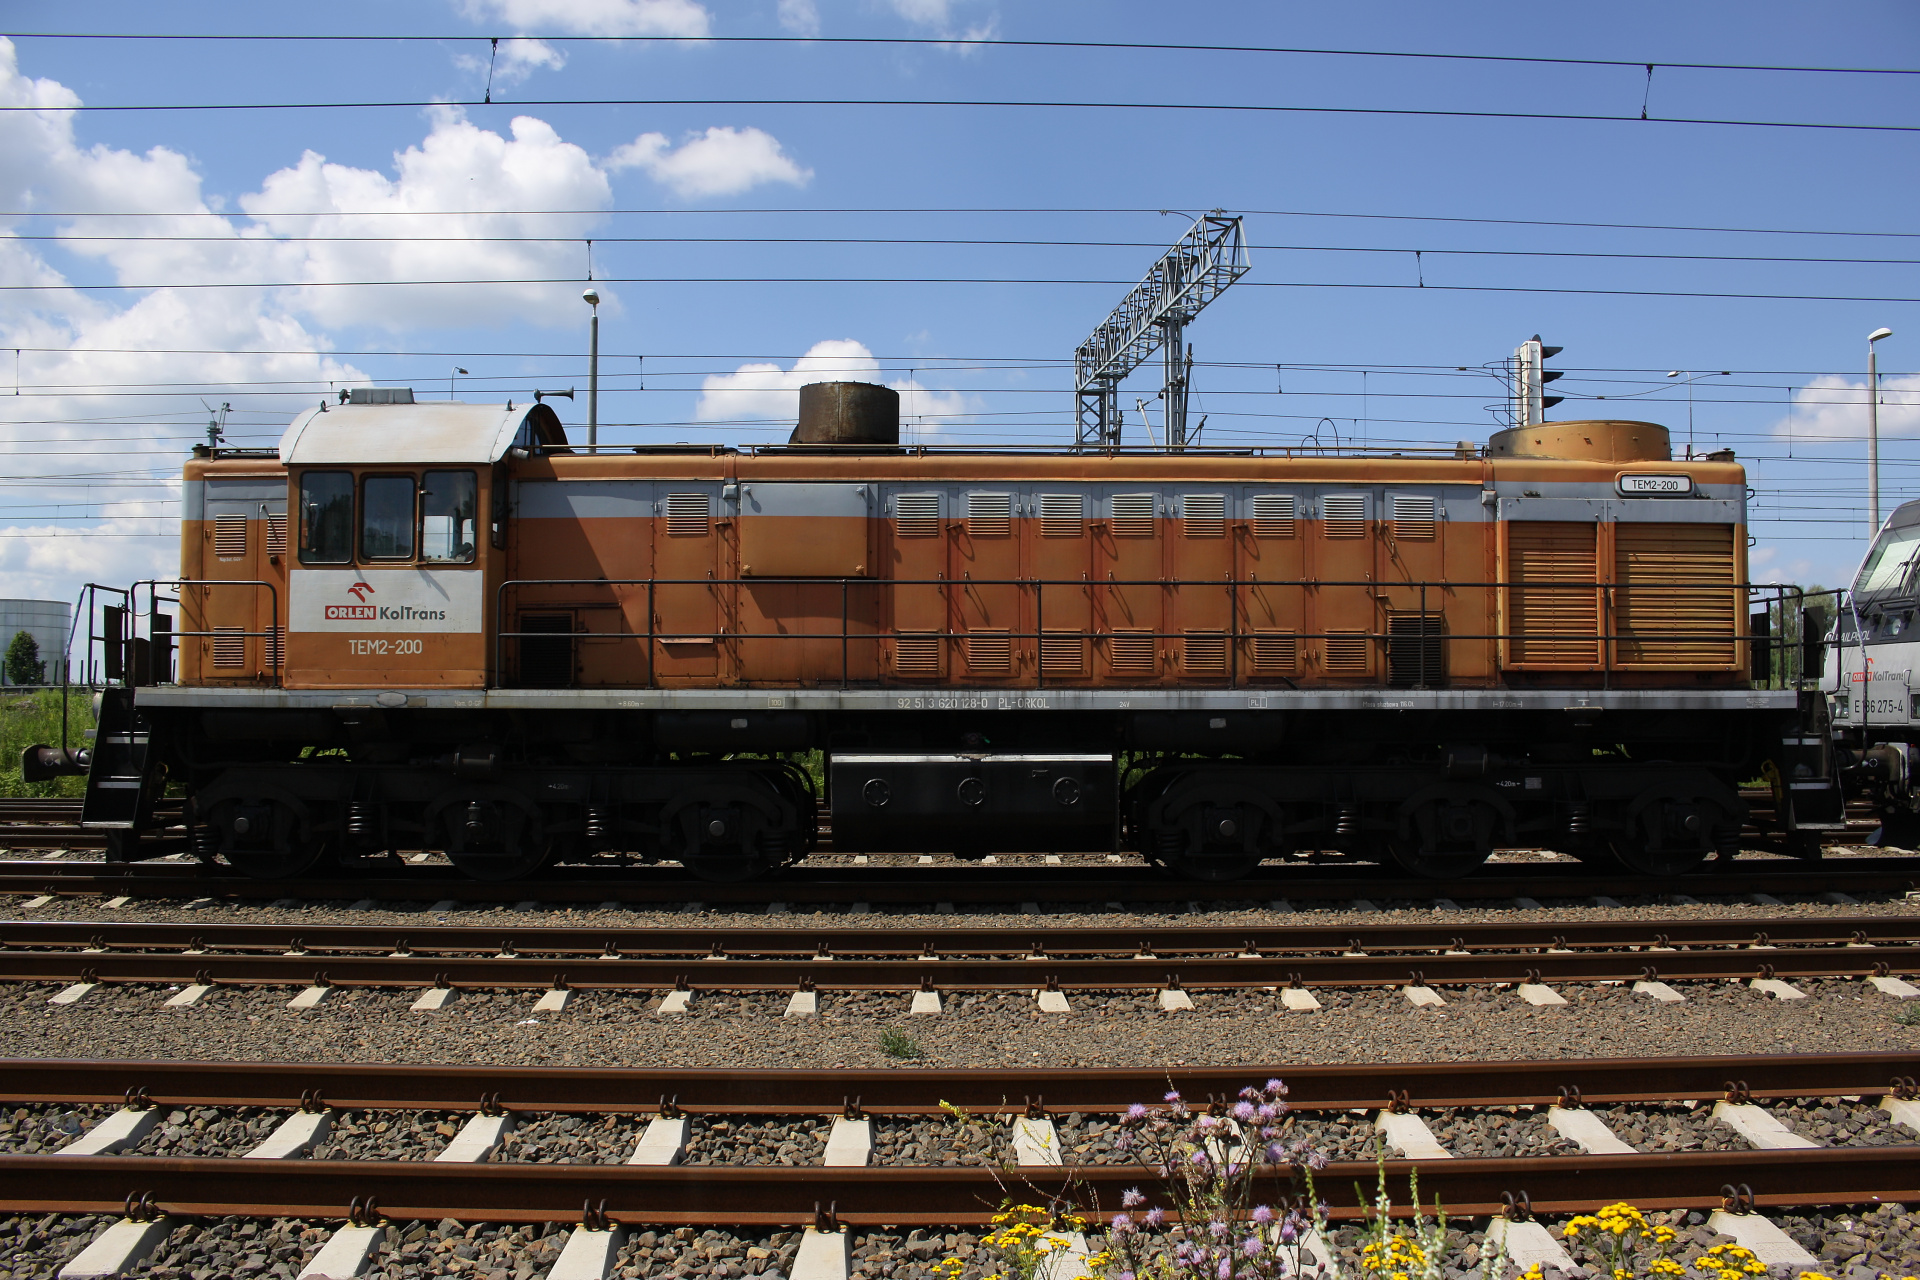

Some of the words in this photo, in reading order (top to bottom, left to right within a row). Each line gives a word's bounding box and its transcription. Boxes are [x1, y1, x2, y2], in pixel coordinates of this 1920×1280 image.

[1632, 479, 1678, 490] TEM2-200
[327, 606, 374, 618] ORLEN
[379, 605, 446, 620] KolTrans
[349, 639, 423, 655] TEM2-200
[1853, 672, 1871, 681] ORLN
[897, 698, 911, 709] 92
[914, 698, 925, 709] 51
[928, 698, 935, 709] 3
[938, 698, 958, 709] 620
[961, 698, 988, 709] 128-0
[998, 698, 1050, 709] PL-ORKOL
[1854, 700, 1860, 713] E
[1862, 700, 1875, 713] 86
[1878, 700, 1903, 713] 275-4
